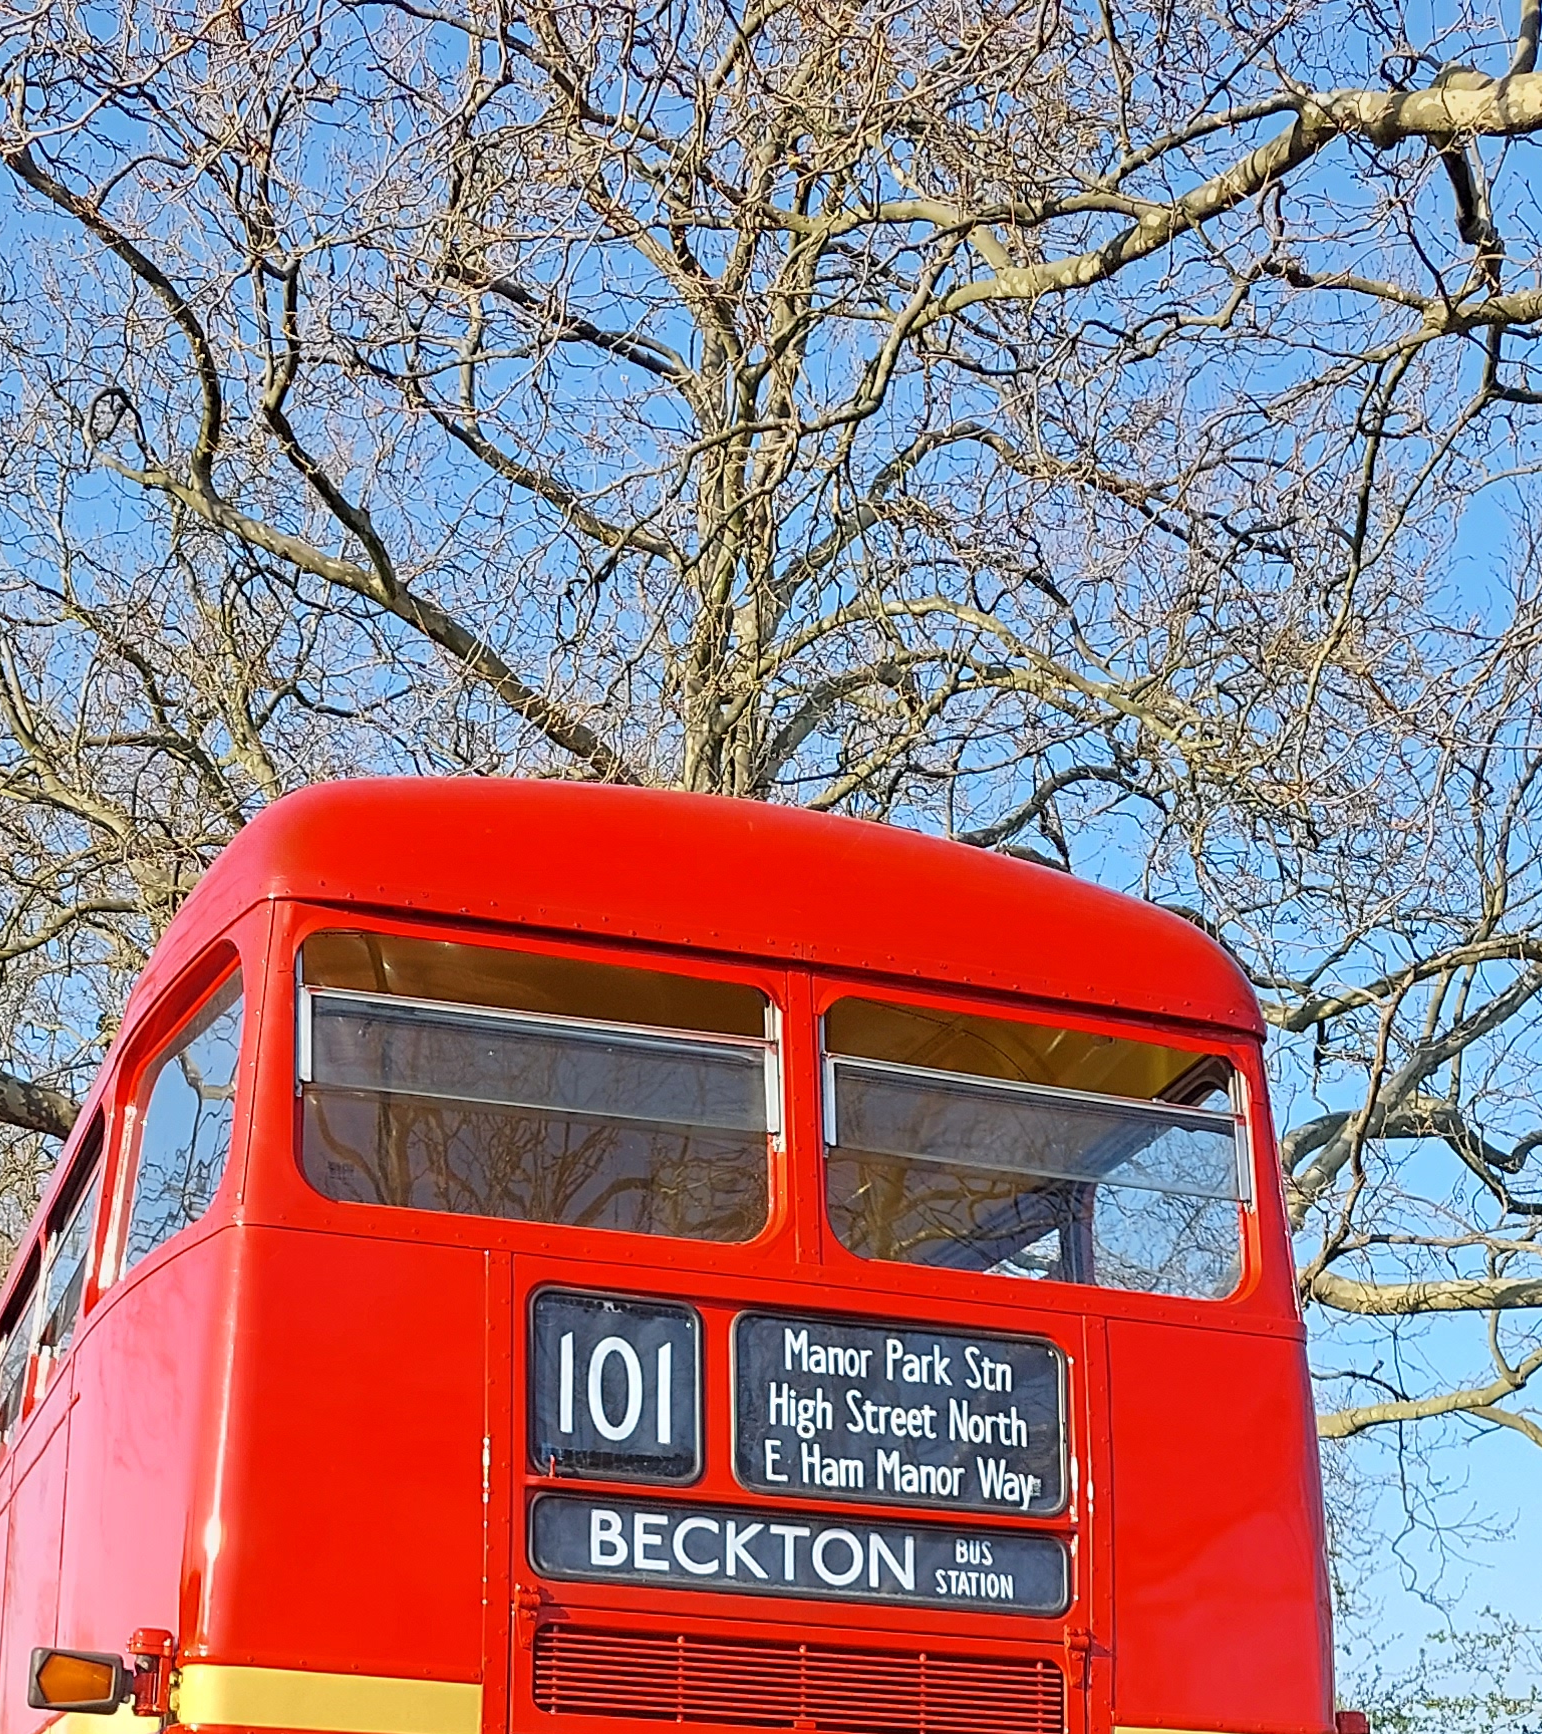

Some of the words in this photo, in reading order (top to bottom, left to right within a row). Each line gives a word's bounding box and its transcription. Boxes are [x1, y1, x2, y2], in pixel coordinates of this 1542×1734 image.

[559, 1331, 672, 1445] 101
[784, 1327, 873, 1378] Manor
[886, 1338, 953, 1386] Park
[964, 1346, 1012, 1393] Stn
[769, 1381, 833, 1439] High
[845, 1389, 938, 1440] Street
[949, 1397, 1028, 1448] North
[764, 1439, 789, 1482] E
[800, 1442, 864, 1488] Ham
[876, 1448, 966, 1497] Manor
[976, 1456, 1035, 1511] Way
[589, 1508, 916, 1592] BECKTON
[955, 1539, 993, 1566] BUS
[935, 1568, 1014, 1600] STATION
